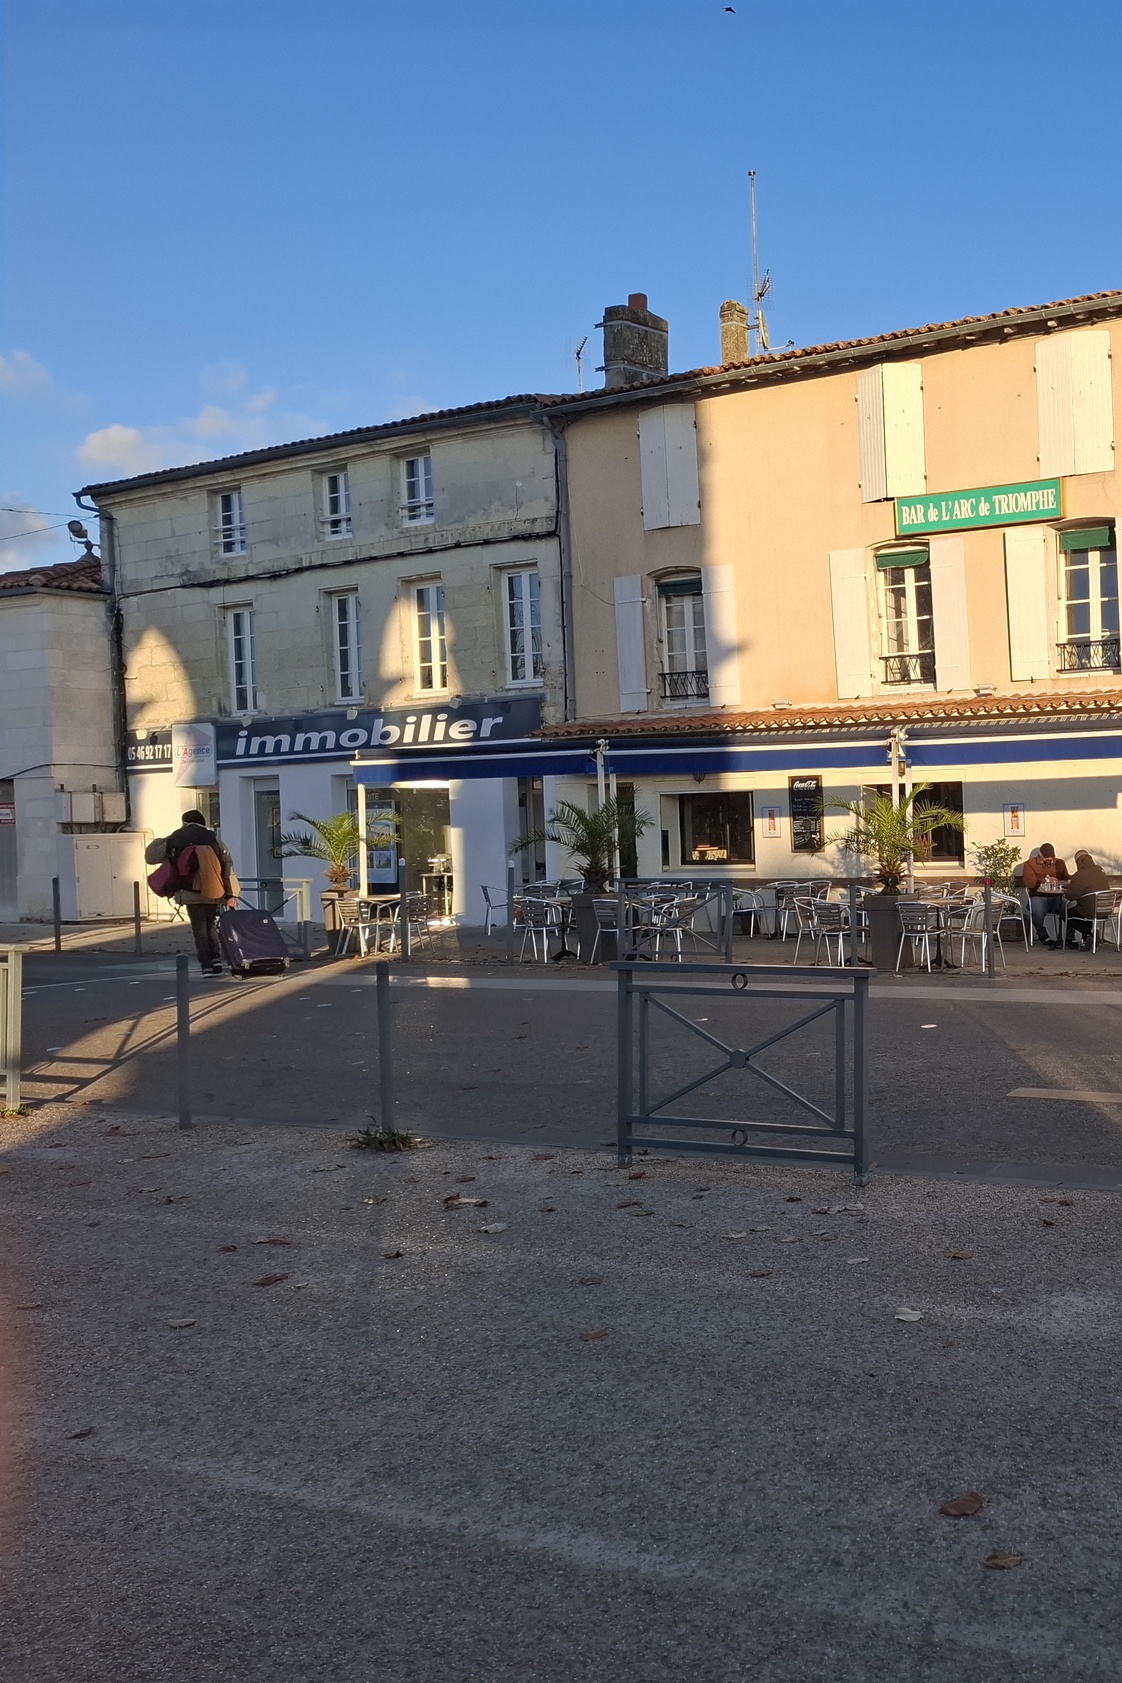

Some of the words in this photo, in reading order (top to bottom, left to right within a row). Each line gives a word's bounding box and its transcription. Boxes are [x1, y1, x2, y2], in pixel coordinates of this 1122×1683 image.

[901, 504, 926, 526] BAR
[927, 502, 939, 522] de
[941, 498, 976, 521] L'ARC
[978, 497, 991, 517] de
[992, 488, 1057, 515] TRIOMPHE
[235, 713, 503, 756] immobilier
[127, 746, 136, 761] 05
[136, 745, 145, 760] 46
[145, 744, 154, 759] 92
[154, 744, 163, 759] 17
[163, 743, 172, 759] 17
[176, 746, 211, 758] L'Agence
